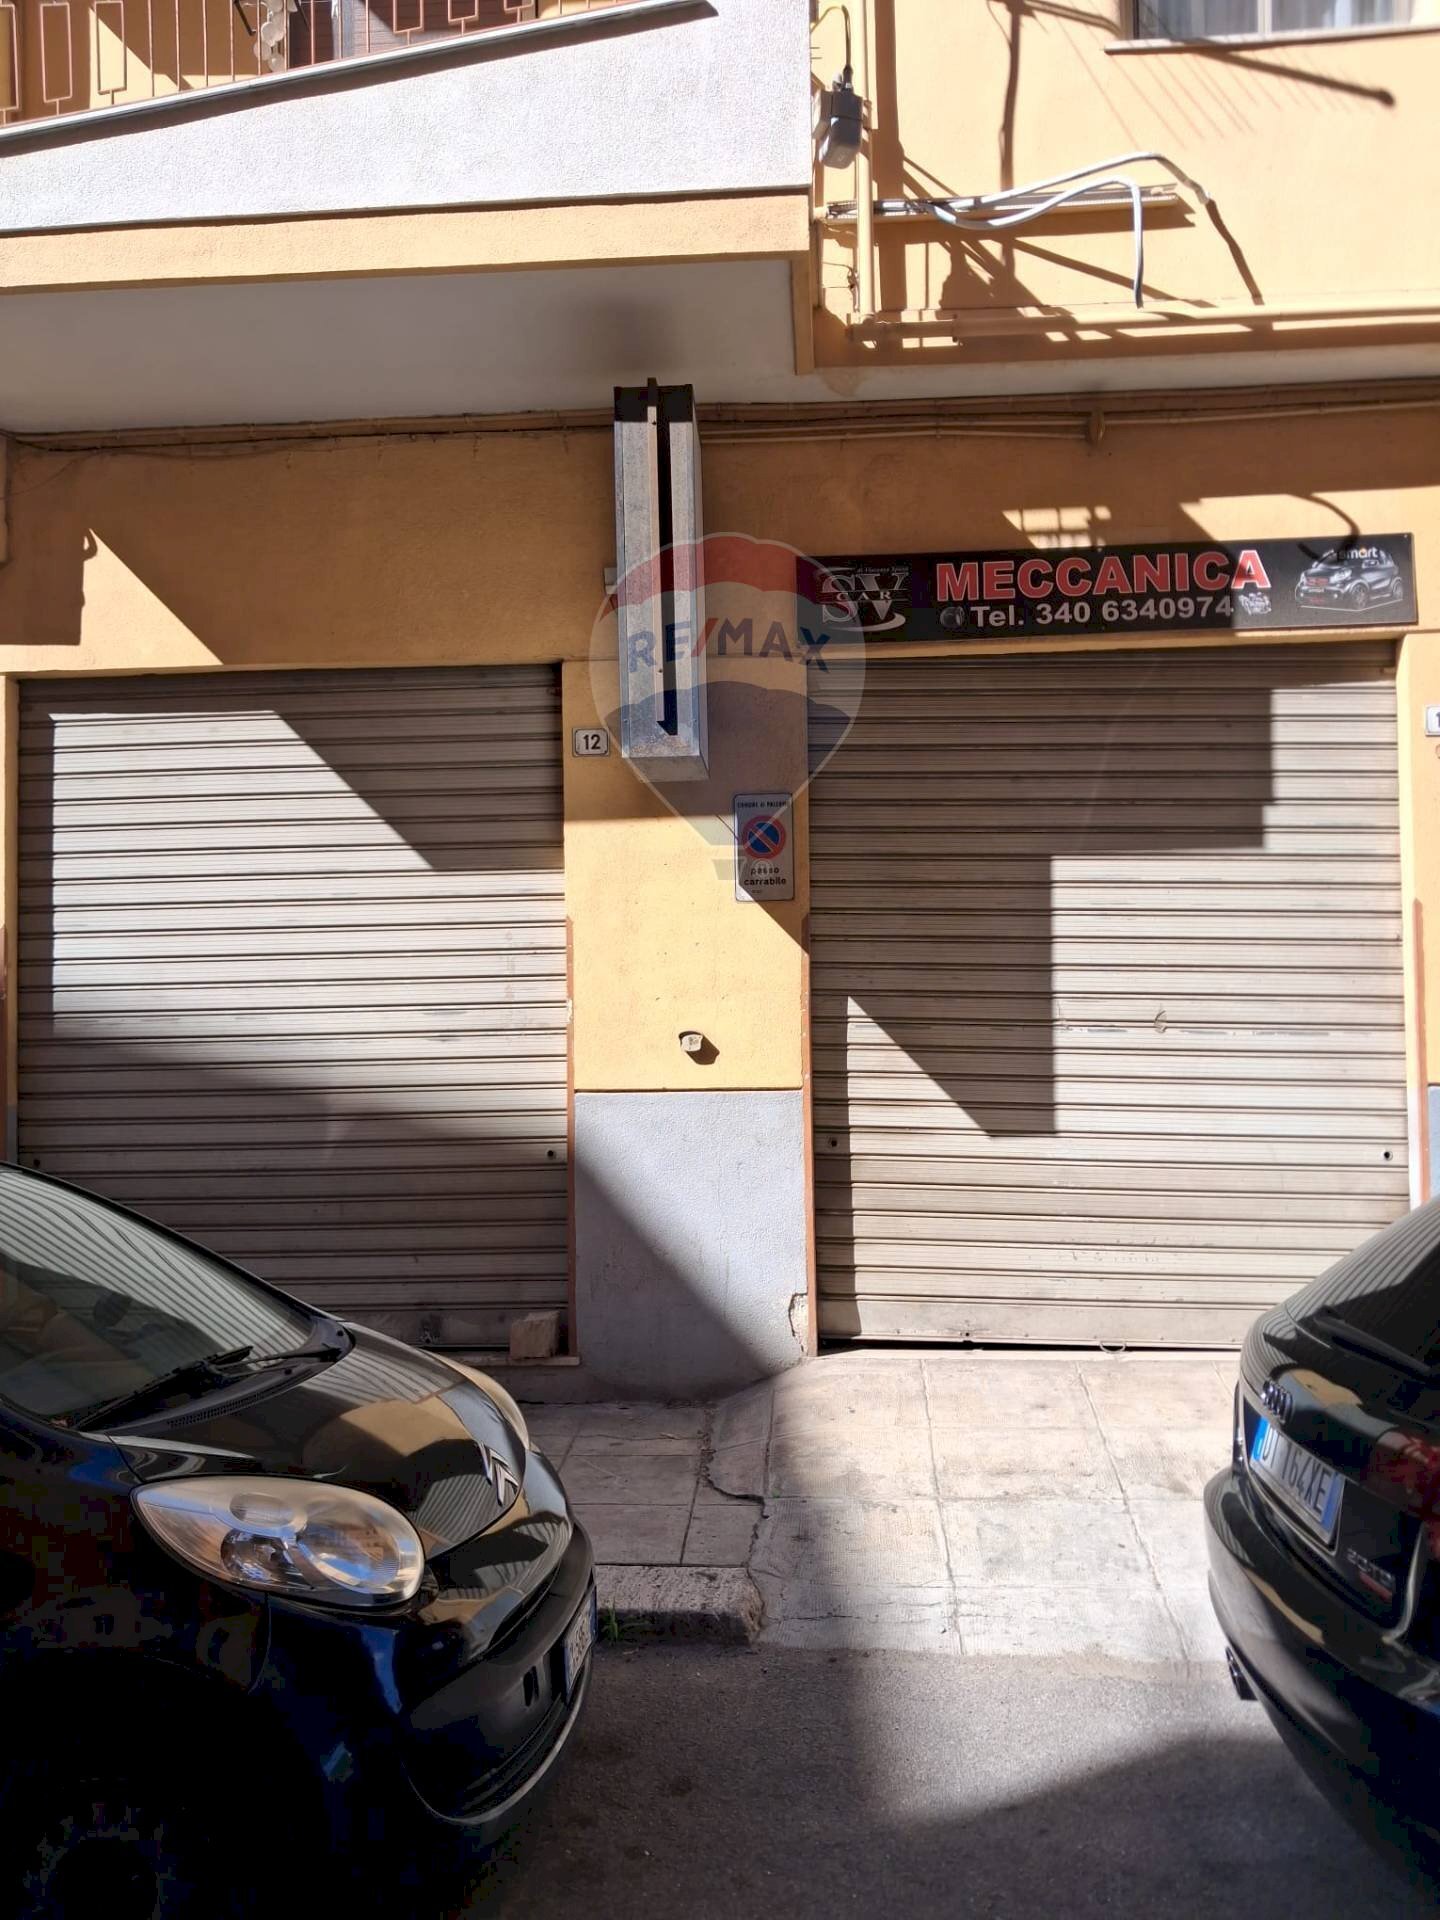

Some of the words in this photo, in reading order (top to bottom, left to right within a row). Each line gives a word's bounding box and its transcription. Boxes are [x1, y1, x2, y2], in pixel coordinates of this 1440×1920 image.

[936, 549, 1272, 602] MECCANICA
[836, 591, 891, 601] CAR
[969, 605, 1025, 629] Tel.
[1035, 601, 1091, 625] 340
[1102, 594, 1232, 622] 6340974
[583, 734, 601, 750] 12
[750, 866, 780, 876] passo
[743, 877, 787, 886] carrabile
